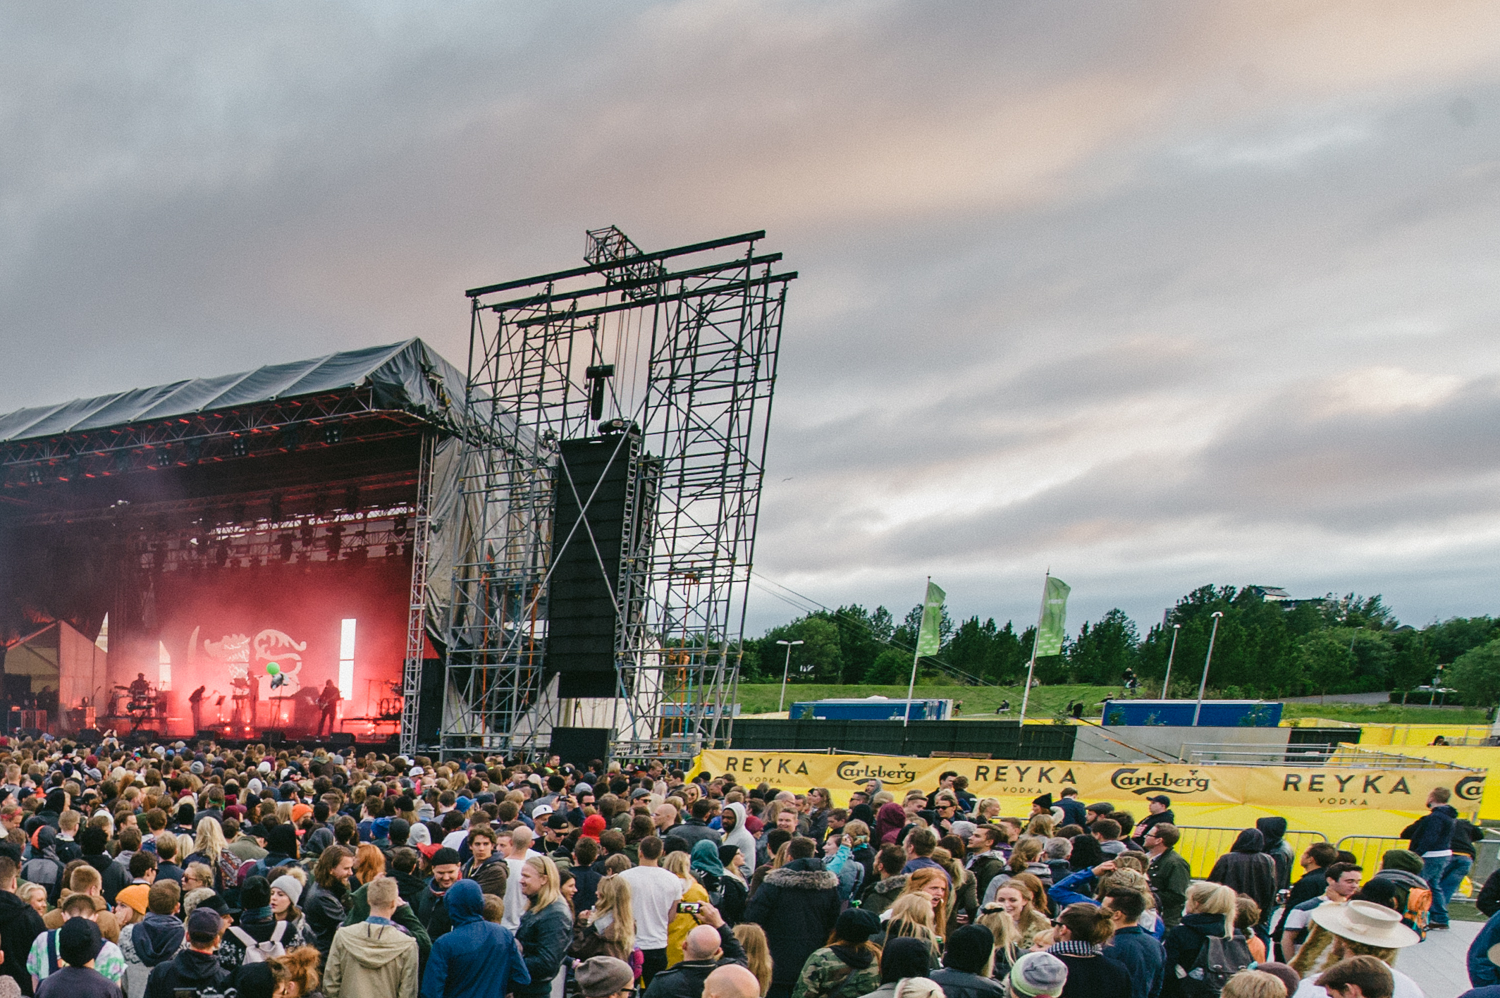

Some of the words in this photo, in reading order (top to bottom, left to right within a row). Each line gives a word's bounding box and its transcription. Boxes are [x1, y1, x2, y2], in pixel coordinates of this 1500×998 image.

[725, 756, 808, 775] REYKA
[836, 760, 916, 785] Carlsberg
[975, 765, 1077, 785] REYKA
[749, 776, 782, 784] VODKA
[1110, 768, 1210, 795] Carlsberg
[1282, 773, 1411, 795] REYKA
[1003, 786, 1042, 794] VODKA
[1318, 797, 1368, 806] VODKA
